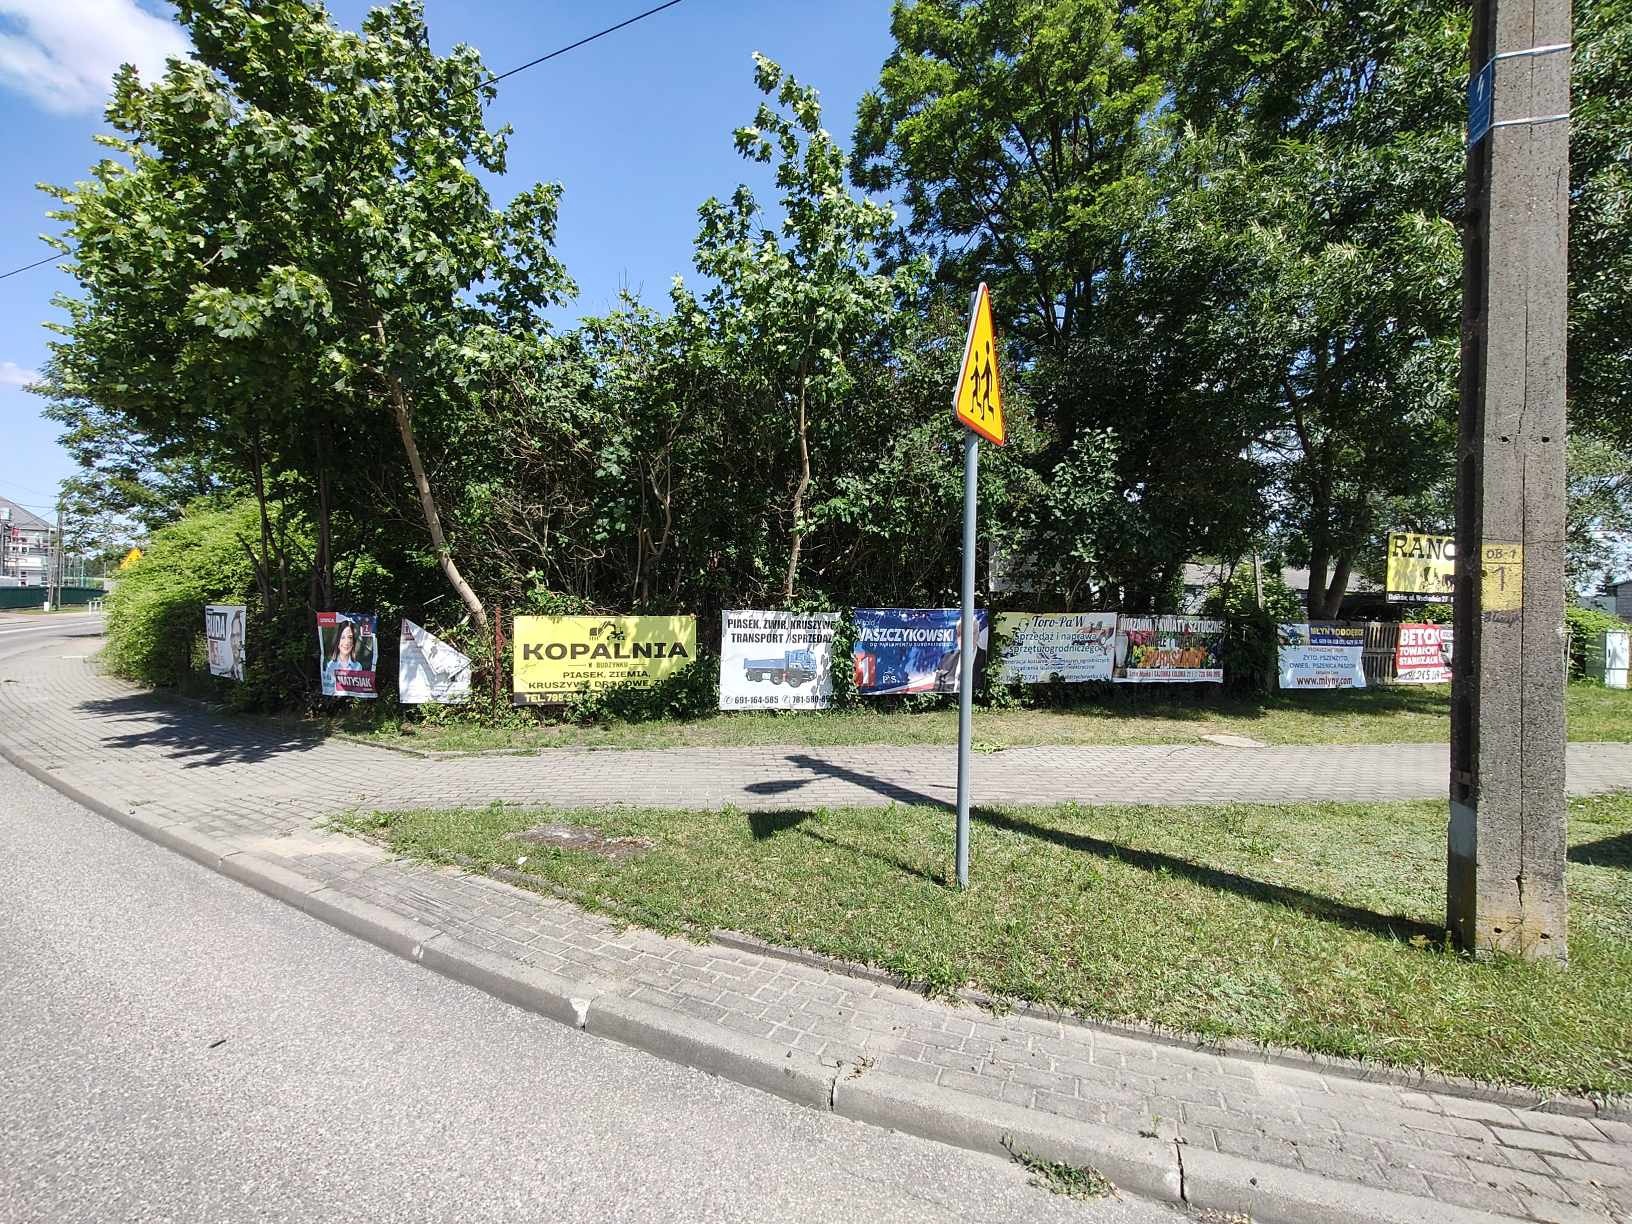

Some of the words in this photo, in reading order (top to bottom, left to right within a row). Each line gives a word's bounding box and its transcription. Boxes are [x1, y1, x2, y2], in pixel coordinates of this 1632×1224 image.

[1491, 565, 1505, 592] 1
[727, 618, 762, 630] PIASEK,
[731, 633, 784, 644] TRANSPORT
[1061, 633, 1097, 642] naprawa
[523, 642, 689, 661] KOPALNIA
[1009, 645, 1044, 655] sprzętu
[1044, 645, 1100, 655] ogrodniczego
[563, 671, 606, 679] PIASEK,
[609, 670, 651, 679] ZIEMIA,
